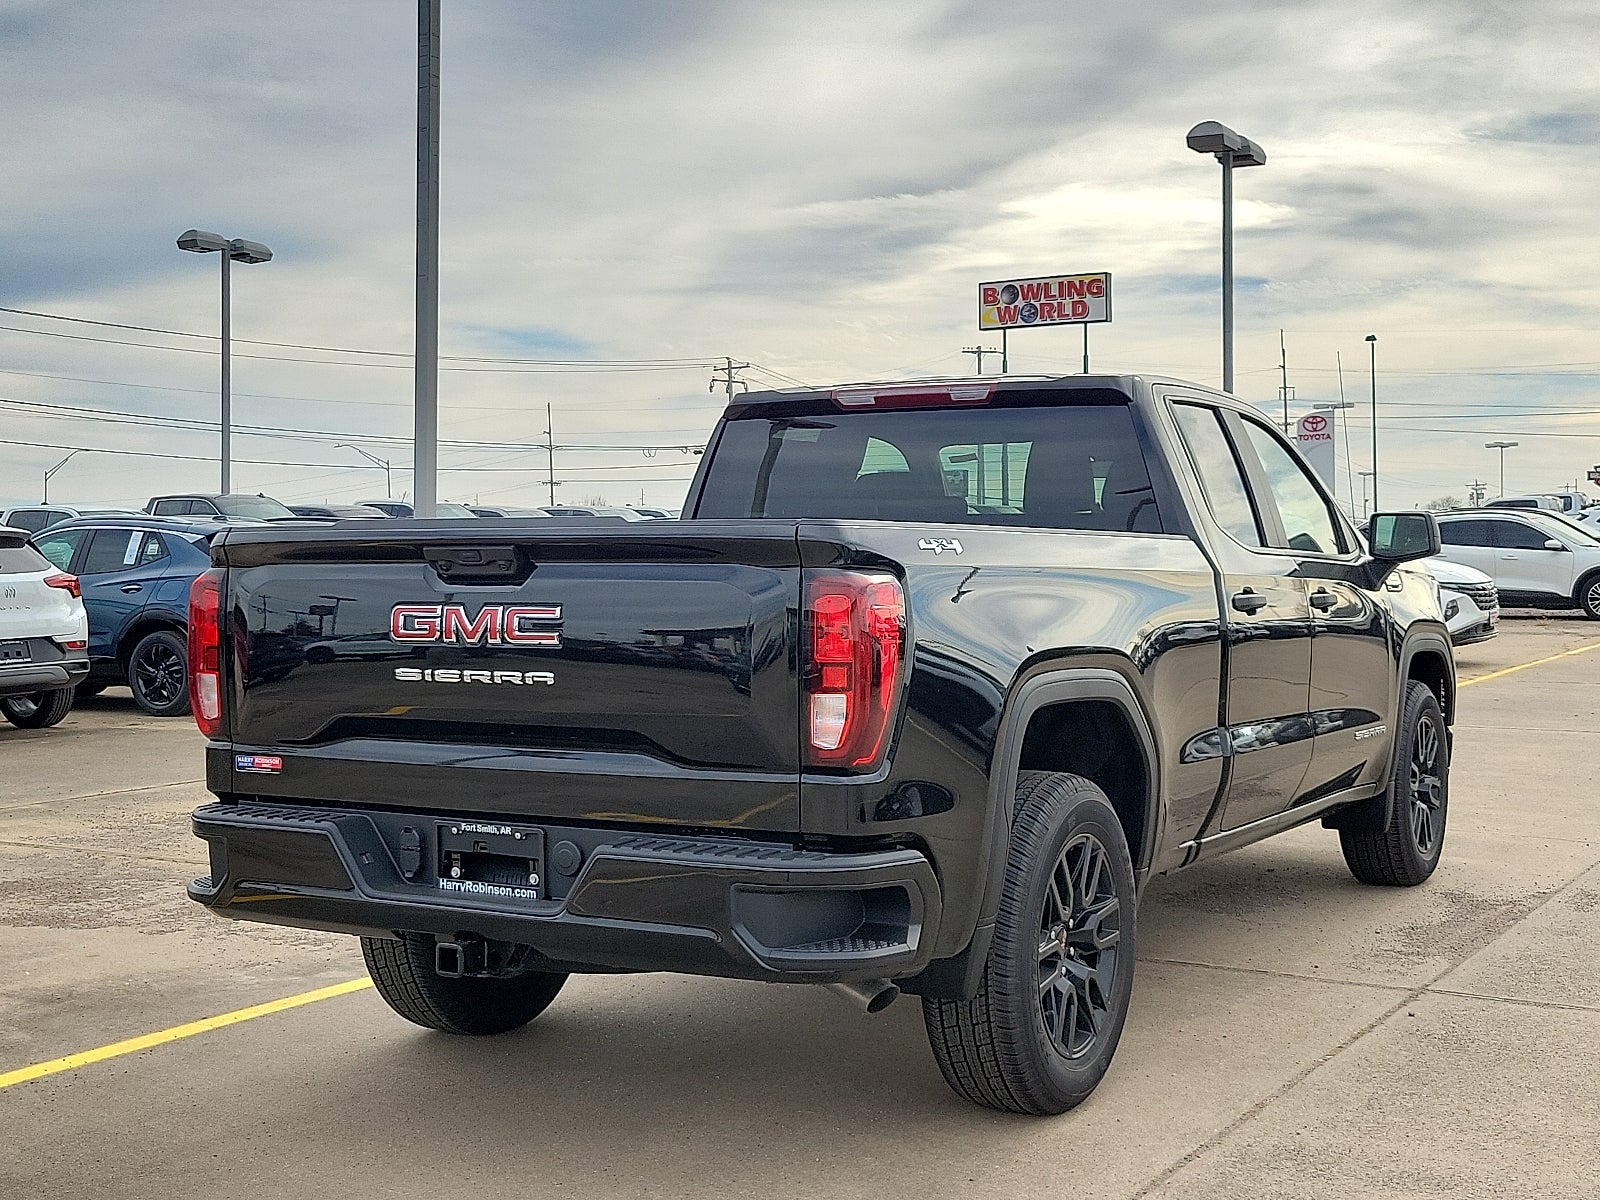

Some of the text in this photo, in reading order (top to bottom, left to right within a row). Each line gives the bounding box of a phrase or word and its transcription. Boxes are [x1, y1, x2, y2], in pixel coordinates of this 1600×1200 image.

[983, 278, 1105, 306] BOWLING
[996, 299, 1090, 325] WORLD
[1298, 433, 1332, 441] TOYOTA
[391, 602, 563, 646] GMC
[394, 667, 555, 685] SIERRA
[1354, 725, 1386, 740] SIERRA
[461, 823, 512, 835] Fort Smith, AR
[440, 879, 536, 899] HarryRobinson.com
